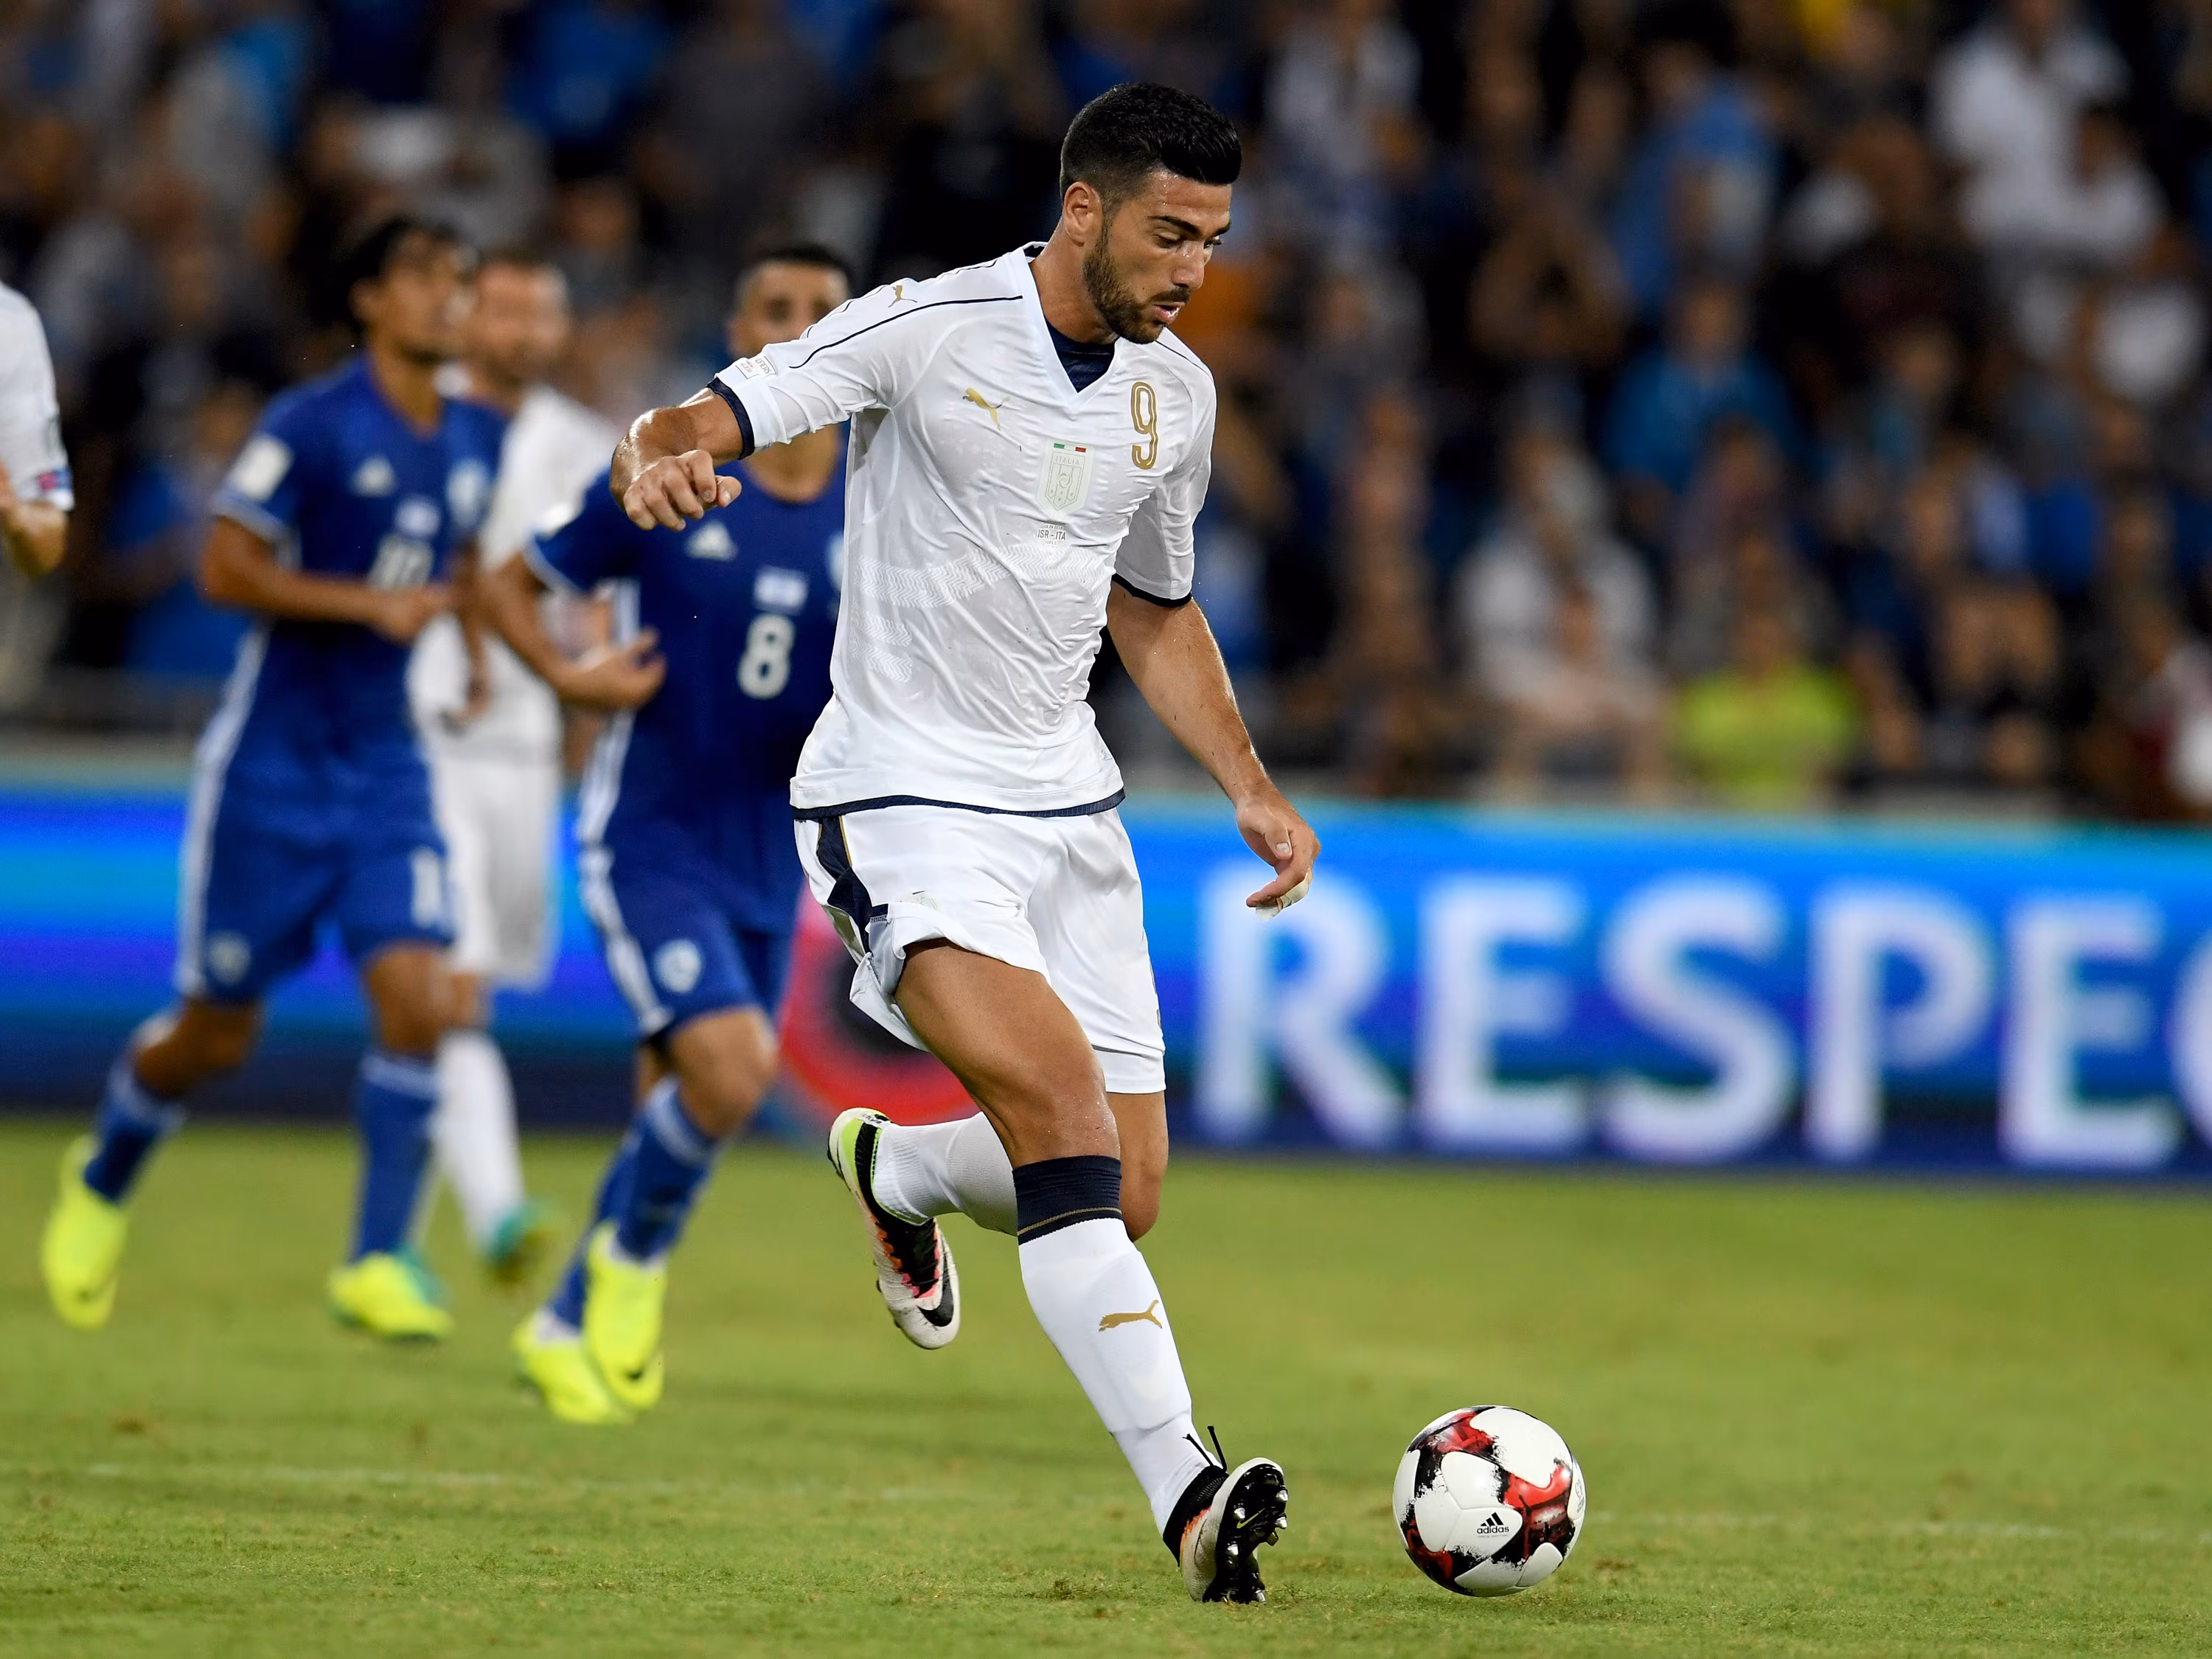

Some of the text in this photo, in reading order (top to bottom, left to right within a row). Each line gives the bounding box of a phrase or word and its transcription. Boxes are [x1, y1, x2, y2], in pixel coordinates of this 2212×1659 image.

[1130, 381, 1158, 470] 9
[1055, 456, 1079, 465] ITALIA
[1037, 529, 1049, 539] ISR
[1055, 531, 1066, 540] ITA
[737, 612, 795, 699] 8
[1476, 1526, 1509, 1534] adidas
